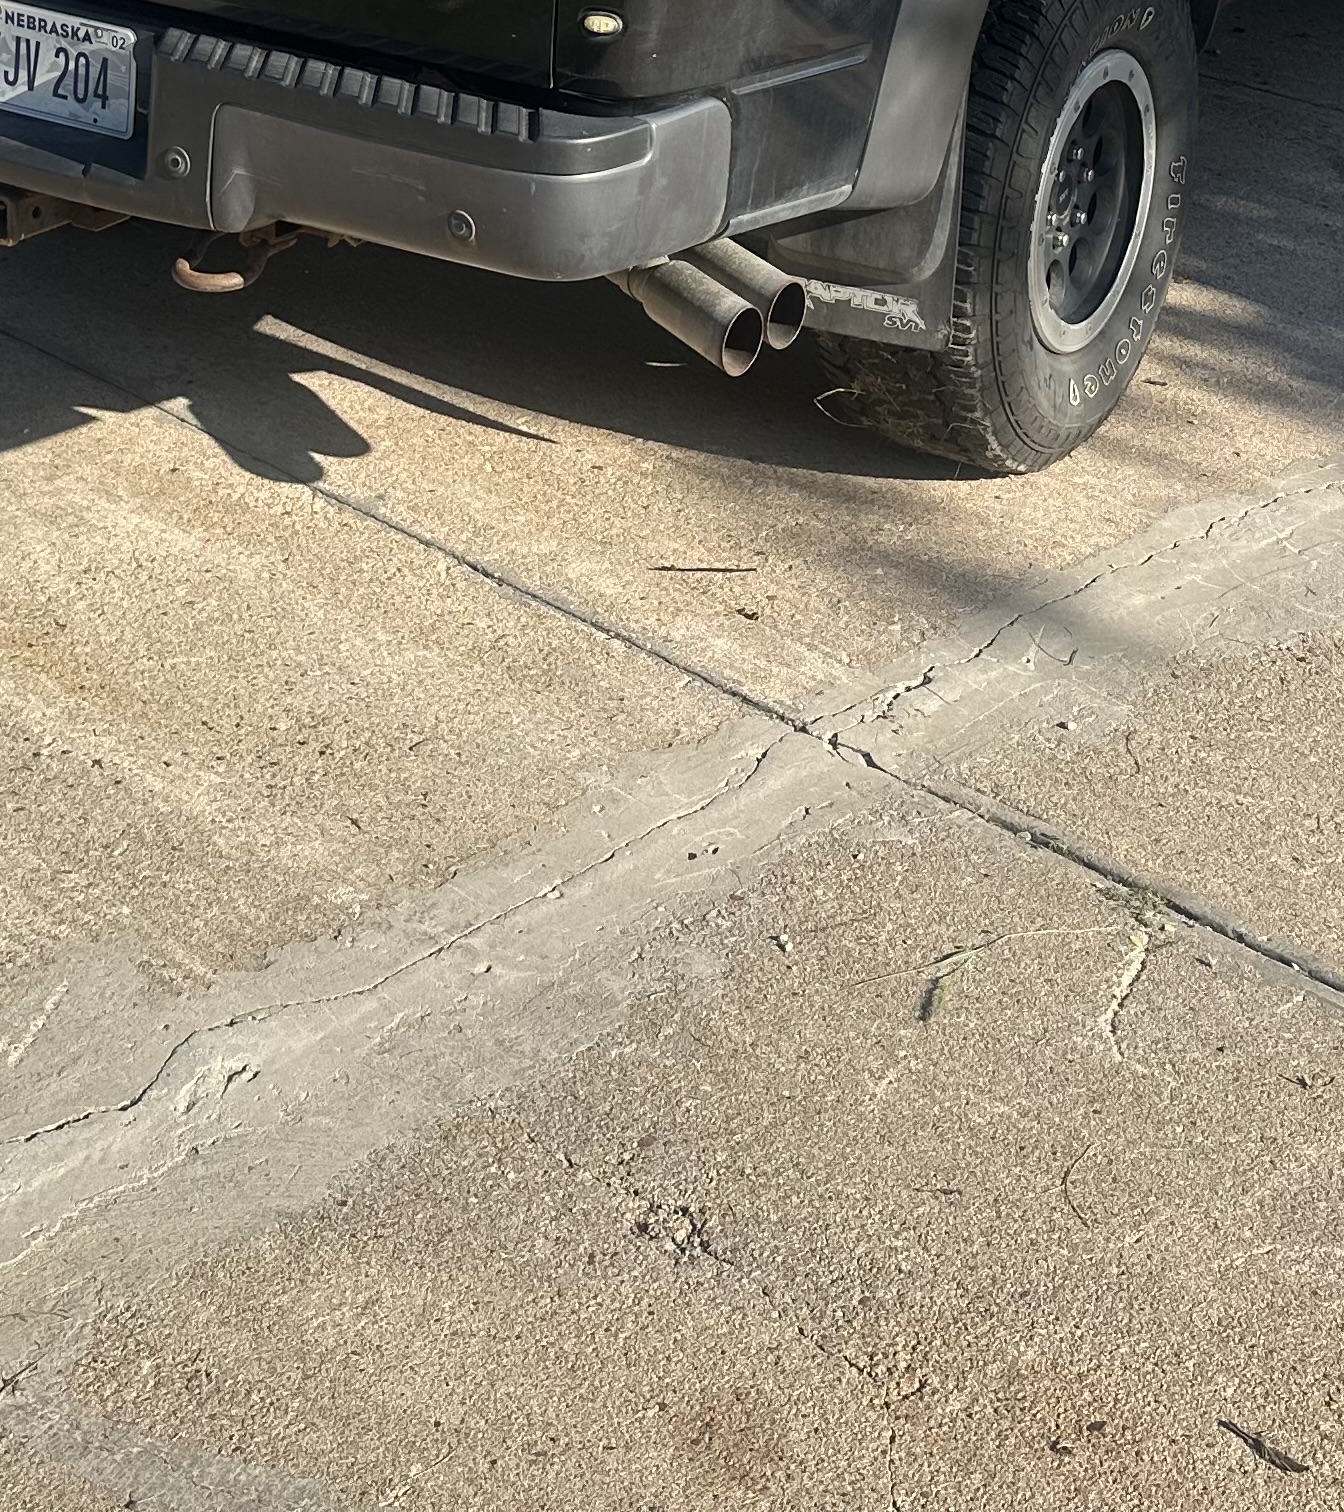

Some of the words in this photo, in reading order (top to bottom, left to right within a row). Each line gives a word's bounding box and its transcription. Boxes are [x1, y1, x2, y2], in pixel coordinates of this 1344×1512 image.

[5, 10, 94, 45] NEBRASKA
[111, 35, 126, 50] 02
[52, 46, 109, 110] 204
[800, 277, 926, 331] APTOR
